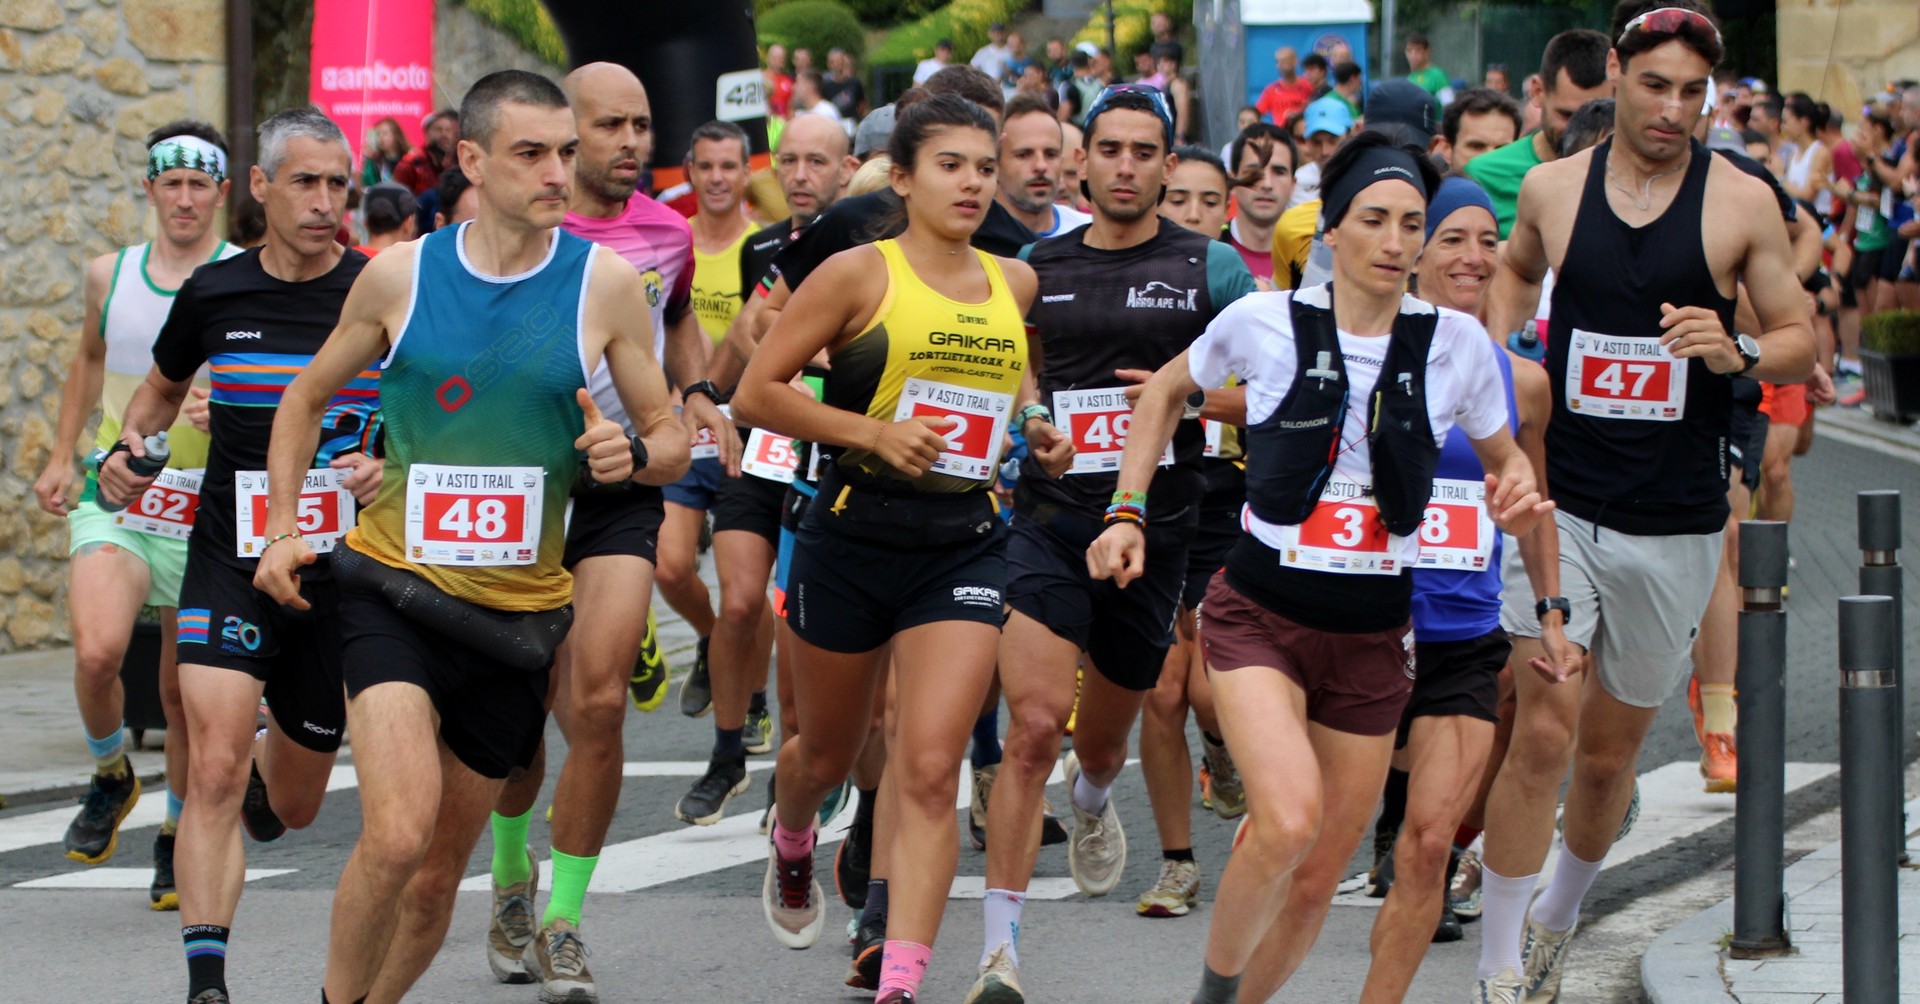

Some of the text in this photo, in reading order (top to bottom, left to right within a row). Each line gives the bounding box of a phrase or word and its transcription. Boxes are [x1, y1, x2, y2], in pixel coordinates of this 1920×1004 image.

[929, 332, 1015, 353] GAIKAR
[1594, 339, 1662, 356] V ASTO TRAIL
[1594, 362, 1656, 397] 47
[928, 387, 990, 411] V ASTO TRAIL
[1077, 396, 1083, 408] V
[1087, 394, 1112, 408] ASTO
[943, 414, 968, 452] 2
[1084, 414, 1132, 449] 49
[1280, 417, 1329, 428] SALOMON
[175, 476, 197, 490] TRAIL
[436, 472, 514, 489] V ASTO TRAIL
[1324, 482, 1354, 497] ASTO
[1442, 485, 1468, 500] TRAIL
[140, 488, 188, 521] 62
[439, 498, 507, 539] 48
[1332, 507, 1364, 547] 3
[953, 587, 999, 600] GAIKAR
[221, 615, 260, 650] 20
